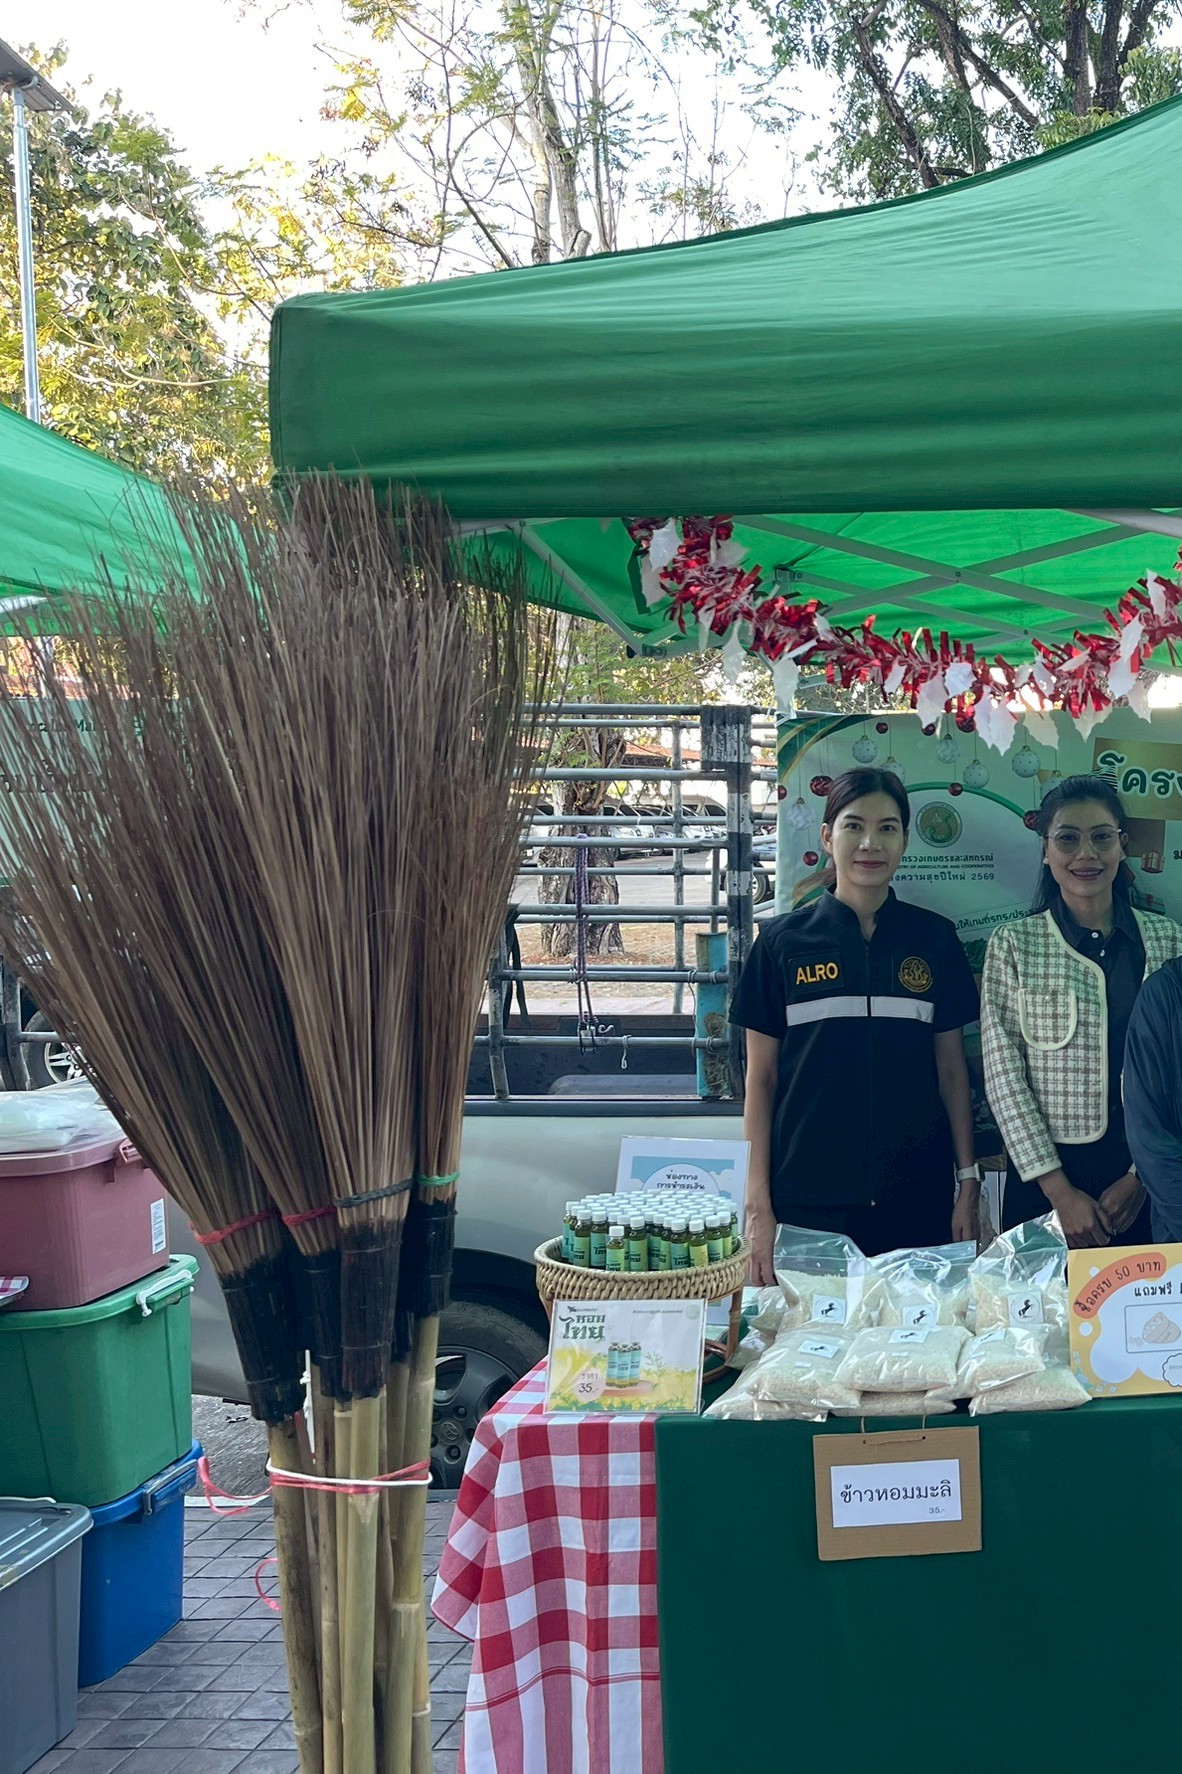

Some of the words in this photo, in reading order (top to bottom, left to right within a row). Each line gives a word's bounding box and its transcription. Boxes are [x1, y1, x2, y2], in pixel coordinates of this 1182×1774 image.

[971, 872, 995, 881] 2569
[796, 962, 839, 985] ALRO
[1115, 1265, 1131, 1281] 50
[1137, 1260, 1161, 1273] บาท
[1134, 1281, 1173, 1297] แถมฟรี
[840, 1479, 952, 1504] ข้าวหอมมะลิ
